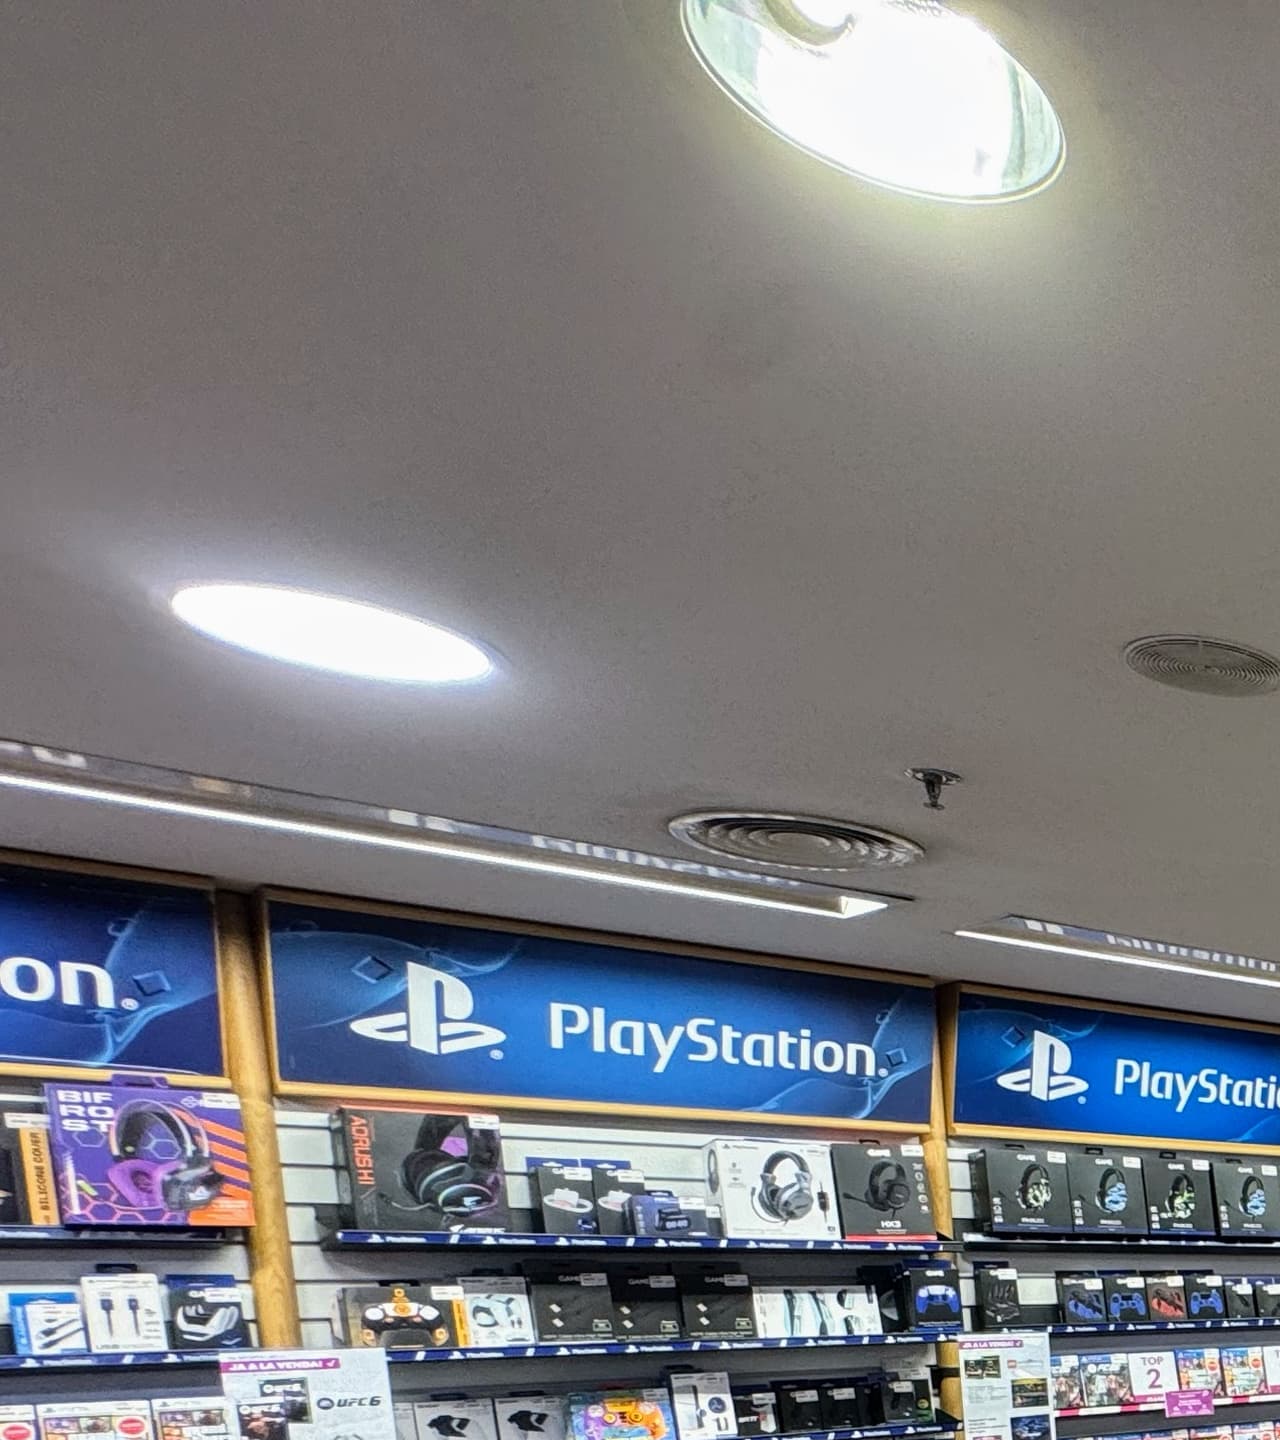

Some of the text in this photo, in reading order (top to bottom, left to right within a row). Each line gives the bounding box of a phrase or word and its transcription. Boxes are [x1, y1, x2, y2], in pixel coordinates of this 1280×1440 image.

[548, 1002, 878, 1078] PlayStation
[56, 1090, 113, 1104] BIF
[60, 1104, 114, 1116] RO
[62, 1119, 115, 1132] ST
[1140, 1356, 1164, 1367] TOP
[1147, 1368, 1163, 1389] 2
[337, 1396, 382, 1408] UFC 6
